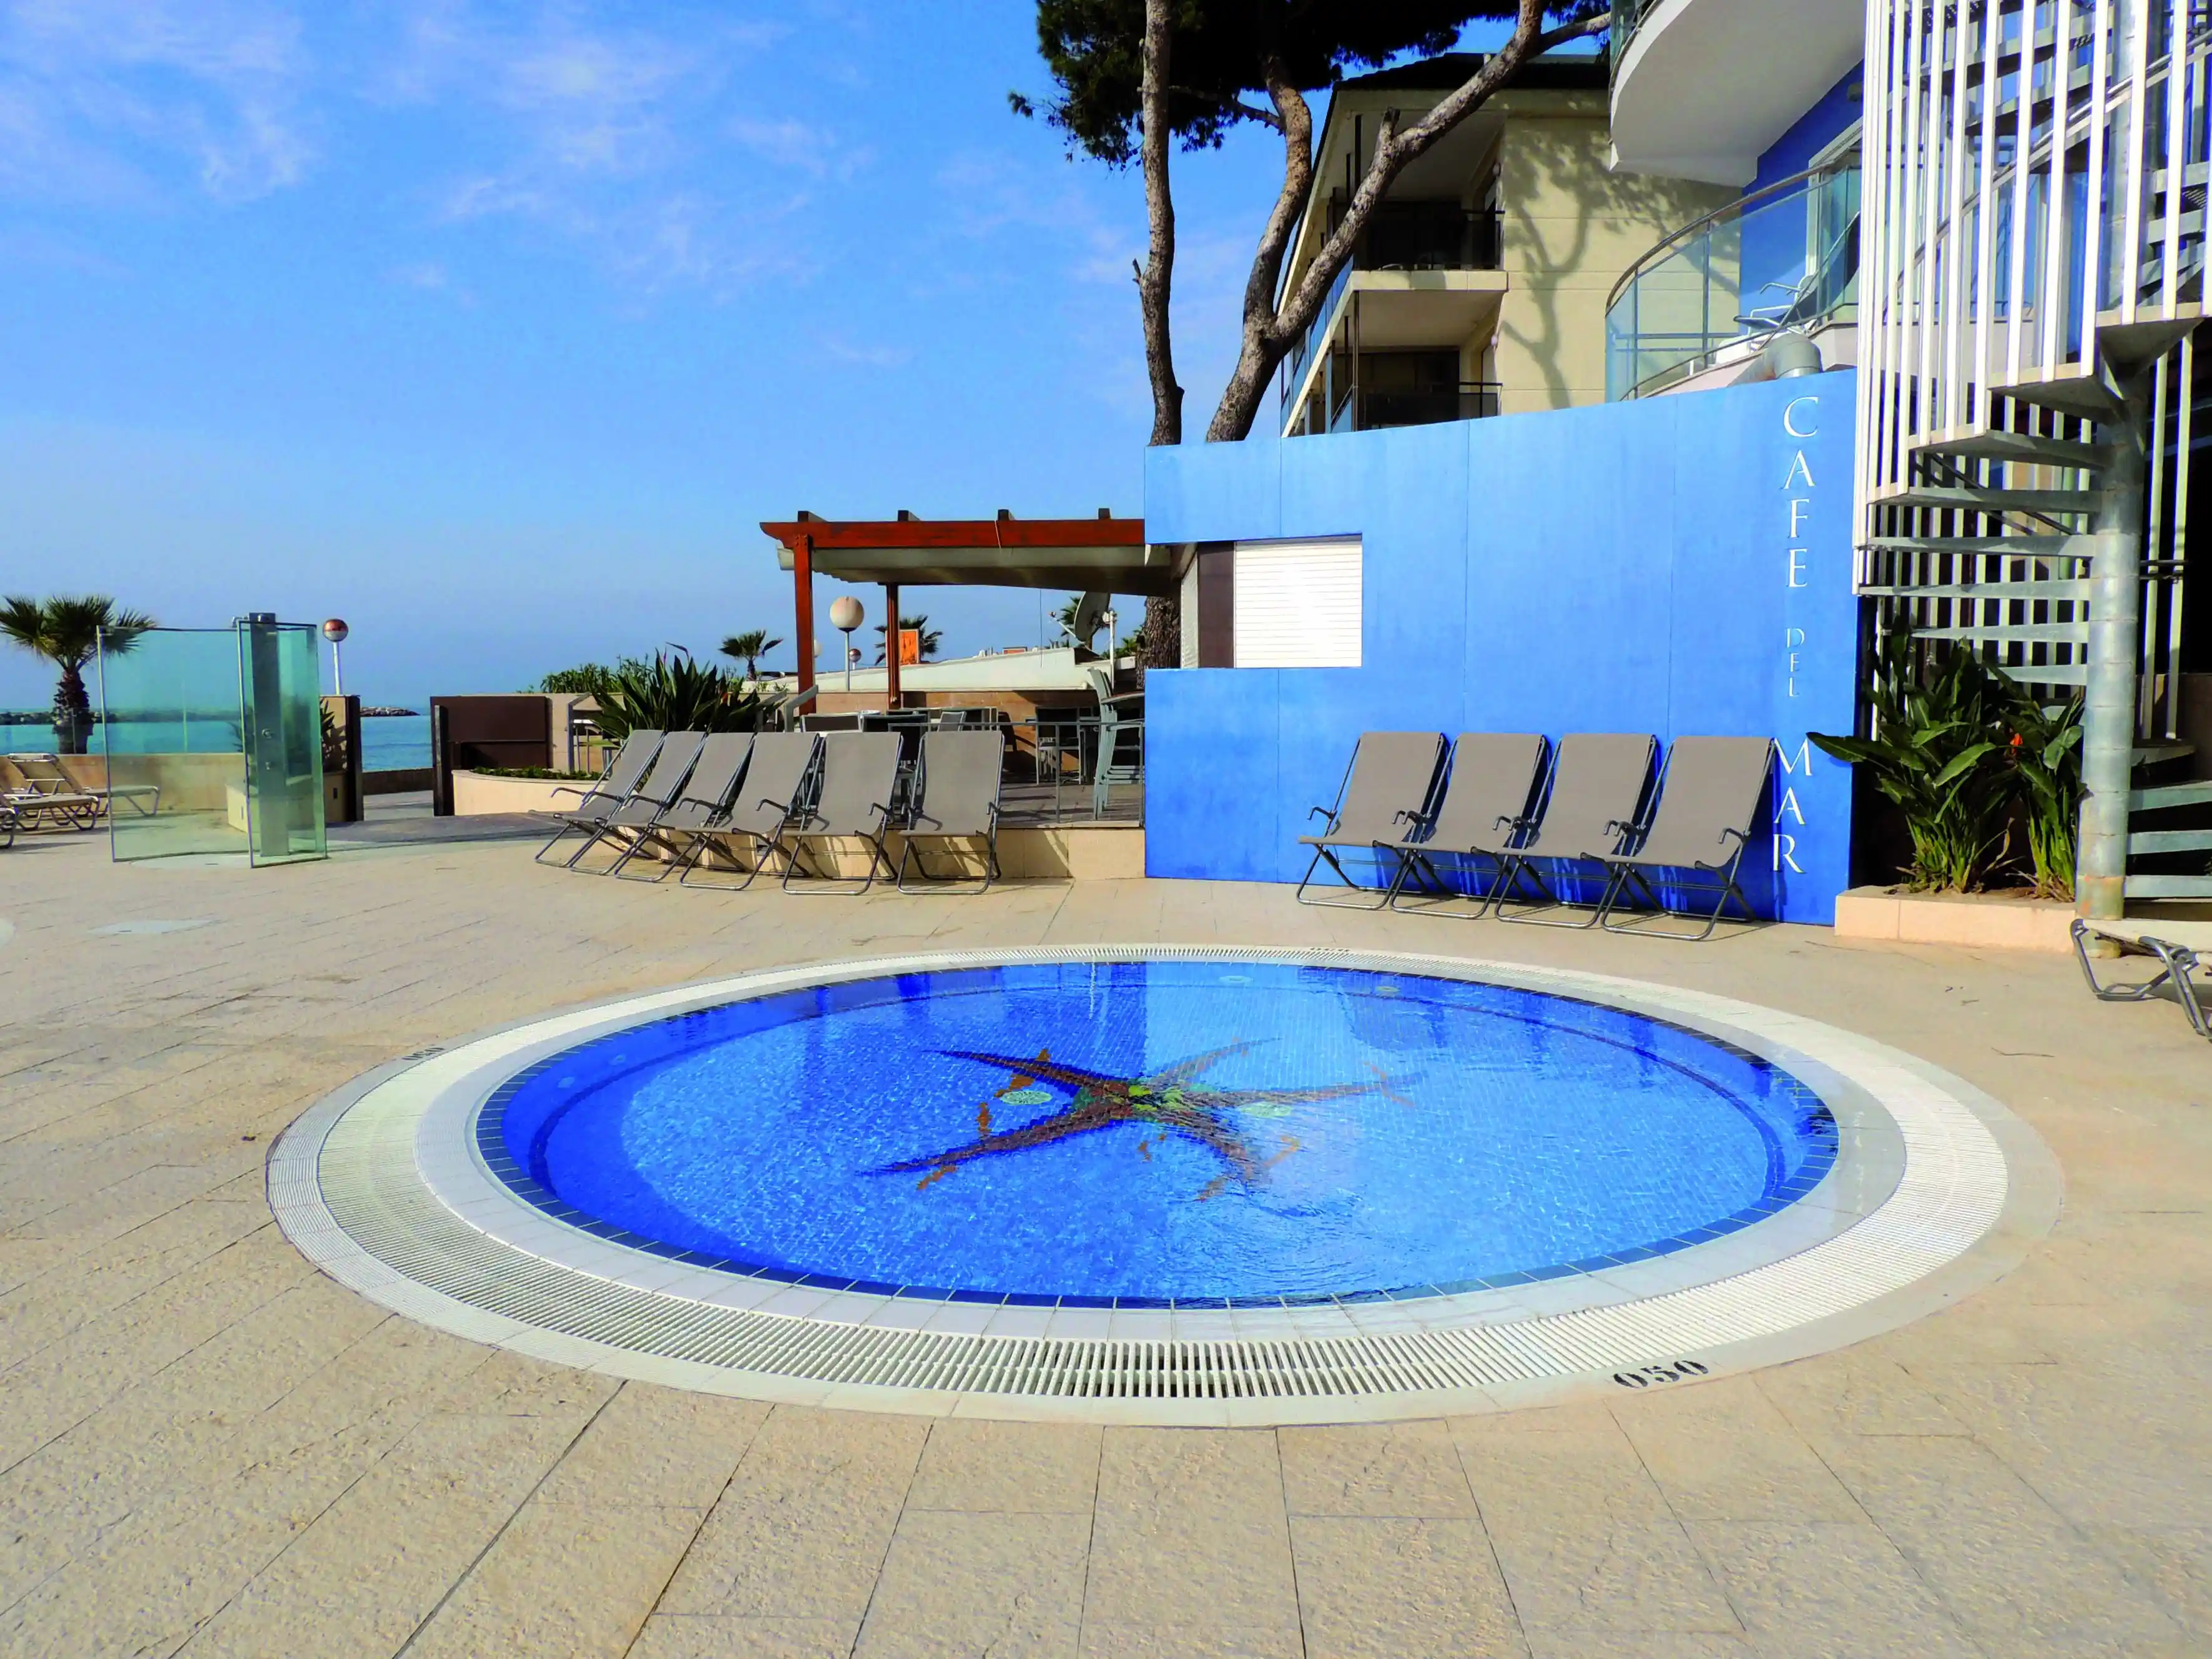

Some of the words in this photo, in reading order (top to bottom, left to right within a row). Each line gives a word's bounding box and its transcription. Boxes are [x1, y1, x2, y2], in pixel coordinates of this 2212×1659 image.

[1781, 395, 1819, 588] CAFE
[1784, 628, 1805, 697] DEL
[1772, 737, 1812, 874] MAR
[1613, 1360, 1709, 1389] 050
